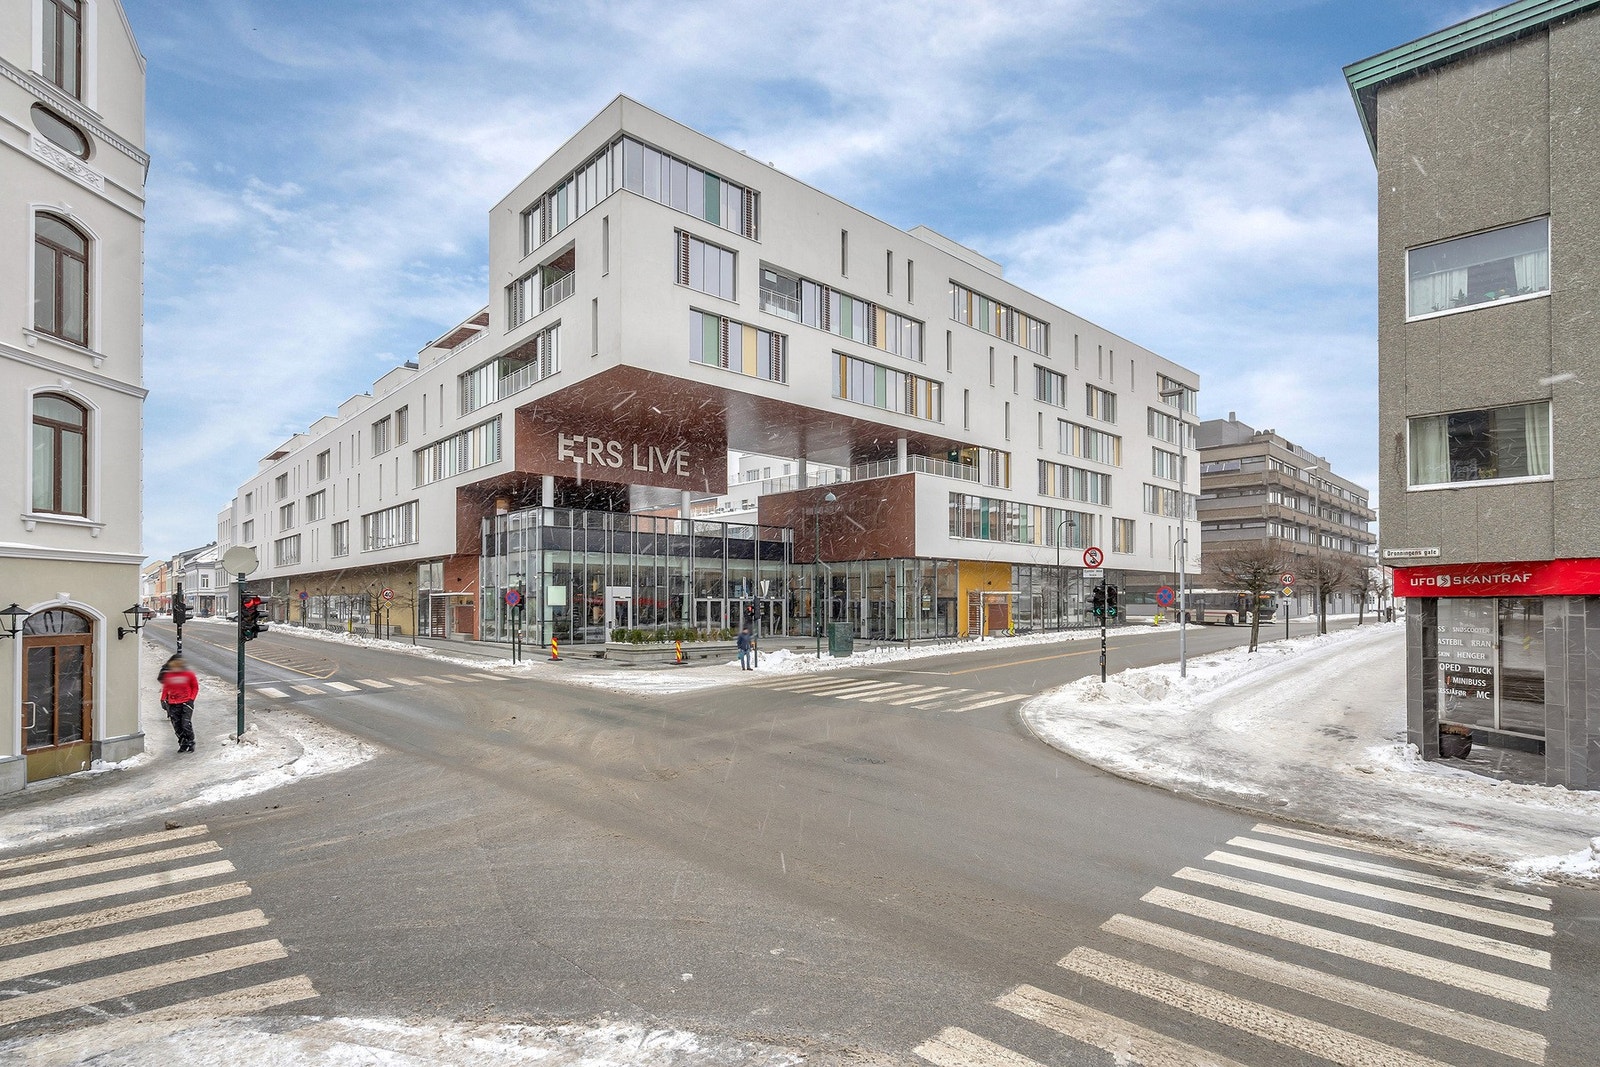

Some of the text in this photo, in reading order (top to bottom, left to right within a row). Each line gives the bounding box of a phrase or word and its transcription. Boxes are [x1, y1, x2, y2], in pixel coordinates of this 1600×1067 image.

[633, 443, 690, 477] LIVE
[1410, 573, 1532, 586] UFO SKANTRAF
[1437, 625, 1446, 633] SS
[1437, 638, 1492, 648] ASTEBIL KRAN
[1437, 650, 1486, 660] SKIN HENGER
[1439, 662, 1492, 675] OPED TRUCK
[1452, 676, 1487, 687] MINIBUSS
[1476, 690, 1491, 700] MC
